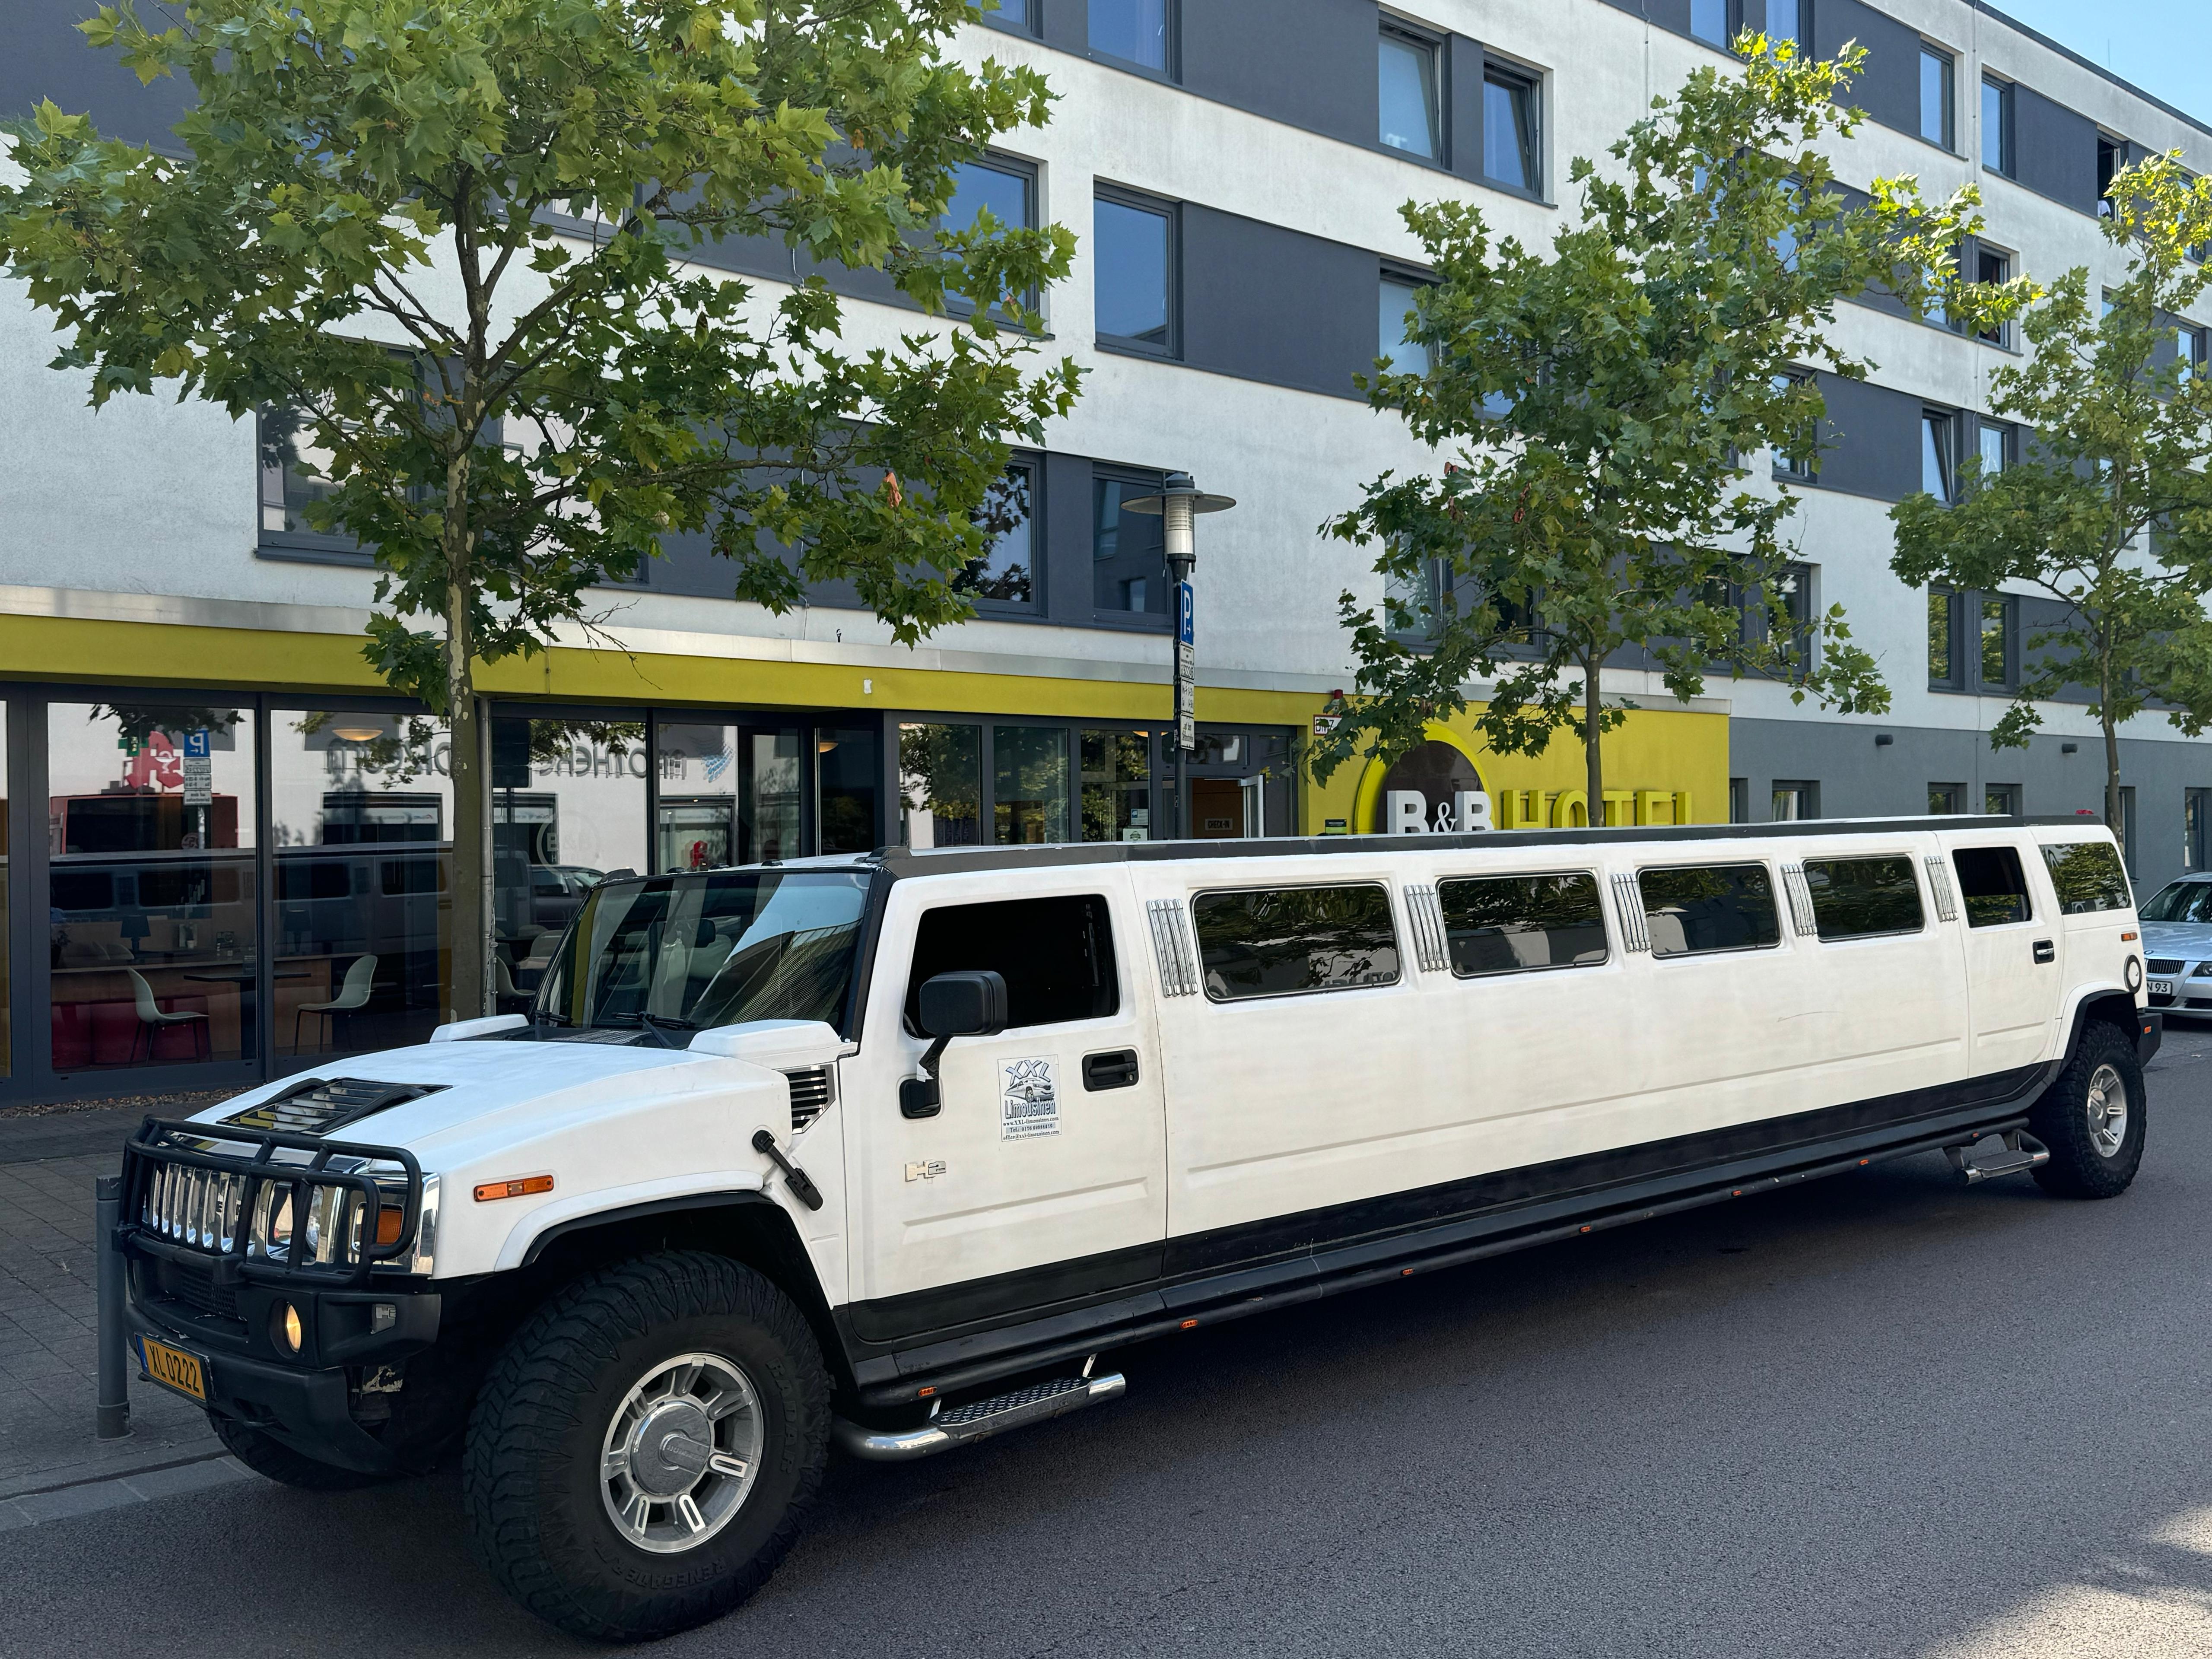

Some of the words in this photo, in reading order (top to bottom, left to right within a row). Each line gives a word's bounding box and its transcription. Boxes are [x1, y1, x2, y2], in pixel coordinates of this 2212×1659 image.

[1184, 589, 1191, 636] P
[1208, 820, 1230, 829] CHECK-IN
[1387, 790, 1495, 834] B&B
[2155, 982, 2168, 992] 93
[1005, 1059, 1051, 1087] XXL
[1004, 1098, 1055, 1119] Limousinen
[149, 1344, 167, 1378] XL
[165, 1351, 200, 1393] 0222
[765, 1357, 798, 1474] RADAR
[625, 1556, 728, 1589] RENEGADE
